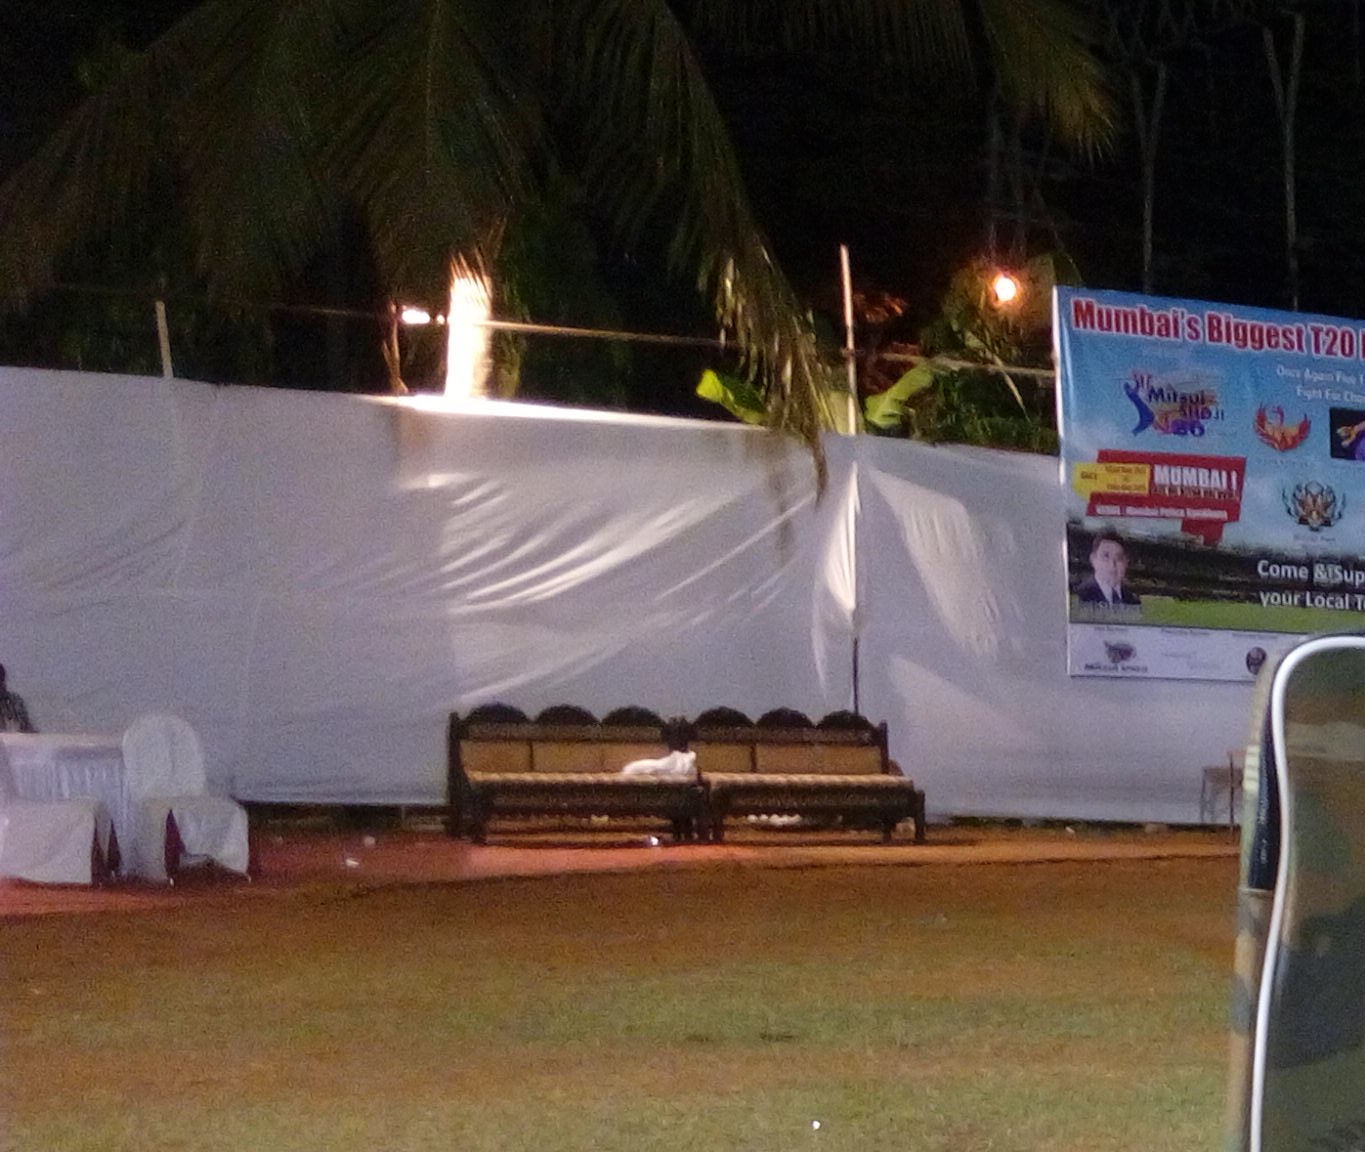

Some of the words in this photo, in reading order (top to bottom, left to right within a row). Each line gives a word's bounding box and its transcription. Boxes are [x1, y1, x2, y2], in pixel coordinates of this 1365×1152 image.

[1072, 298, 1202, 342] Mumbai's
[1206, 311, 1305, 353] Biggest
[1308, 323, 1356, 359] T20
[1257, 559, 1309, 580] Come
[1260, 590, 1300, 607] your
[1305, 590, 1350, 610] Local
